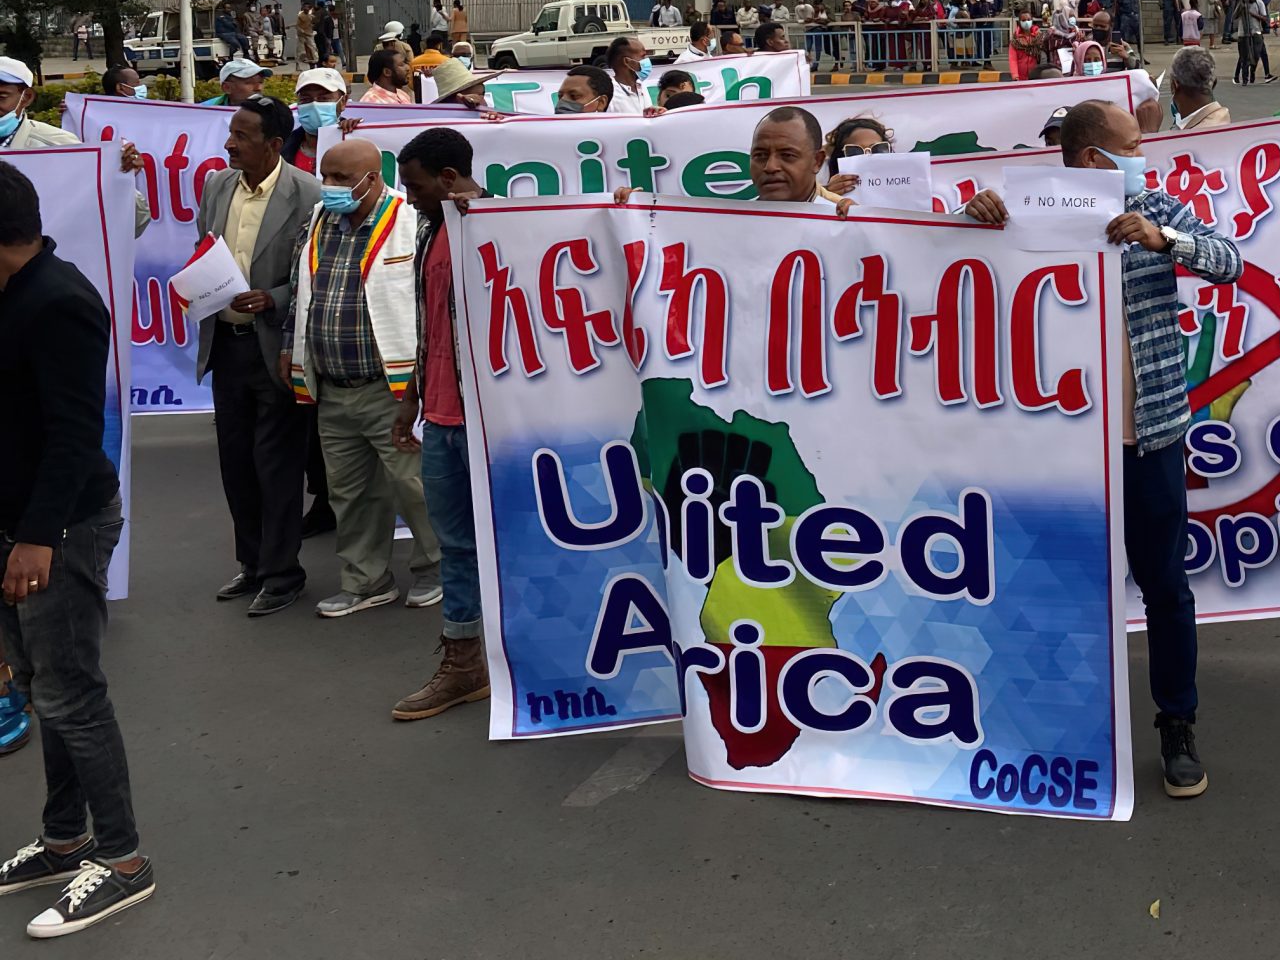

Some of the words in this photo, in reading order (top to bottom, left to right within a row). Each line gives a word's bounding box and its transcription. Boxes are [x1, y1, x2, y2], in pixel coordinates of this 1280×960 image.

[651, 36, 690, 44] TOYOTA
[868, 178, 882, 187] NO
[886, 176, 911, 186] MORE
[1024, 195, 1031, 207] #
[1038, 196, 1055, 207] NO
[1062, 196, 1096, 208] MORE
[535, 443, 991, 603] Uited
[590, 577, 980, 744] Arica
[969, 748, 1099, 809] CoCSE
